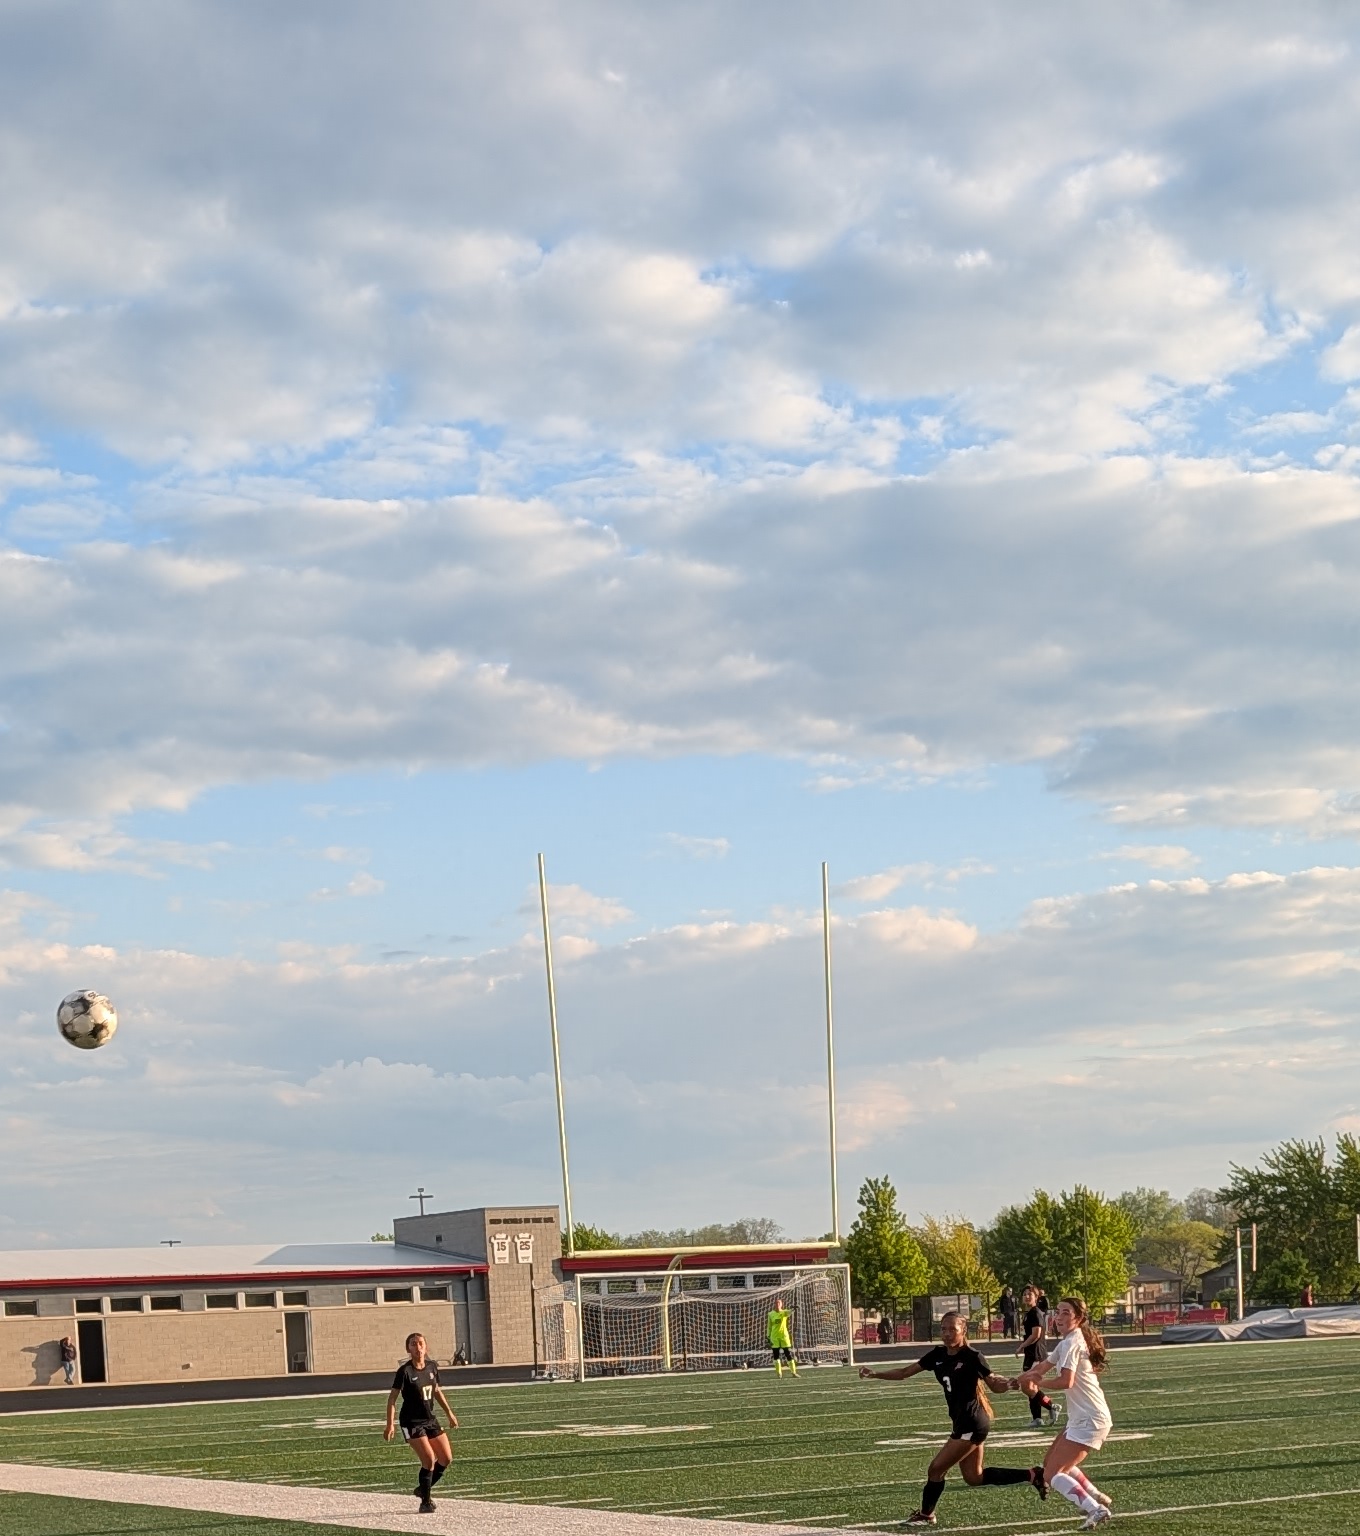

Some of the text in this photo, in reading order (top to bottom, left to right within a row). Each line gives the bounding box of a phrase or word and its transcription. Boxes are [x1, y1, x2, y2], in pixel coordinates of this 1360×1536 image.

[496, 1241, 507, 1251] 15
[519, 1240, 531, 1250] 25
[422, 1385, 432, 1400] 17
